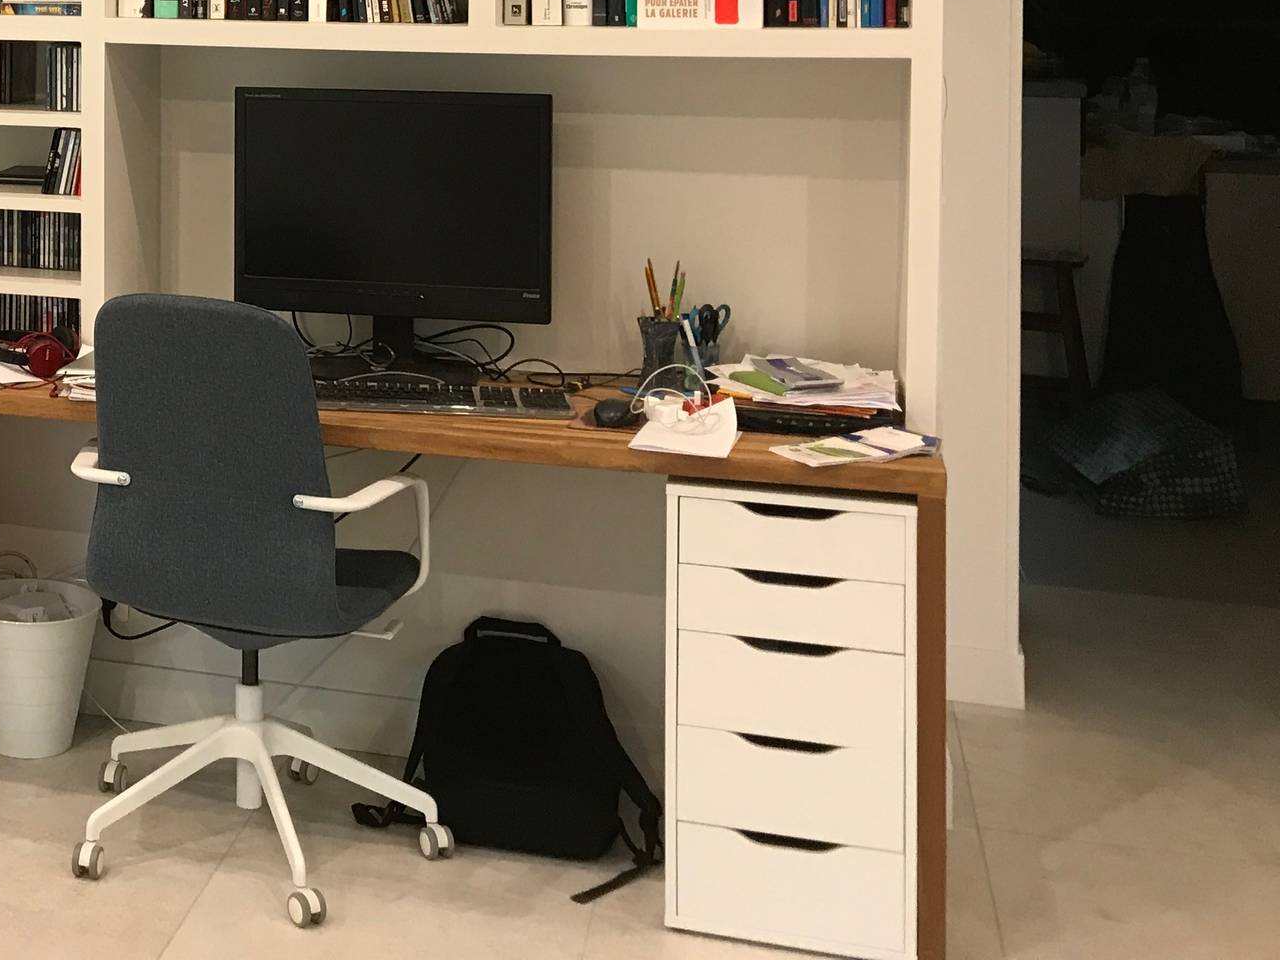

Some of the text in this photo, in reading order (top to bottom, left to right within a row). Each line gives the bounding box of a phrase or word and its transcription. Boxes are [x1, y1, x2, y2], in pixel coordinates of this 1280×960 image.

[381, 0, 390, 13] SUR
[645, 7, 698, 18] LA GALERIE
